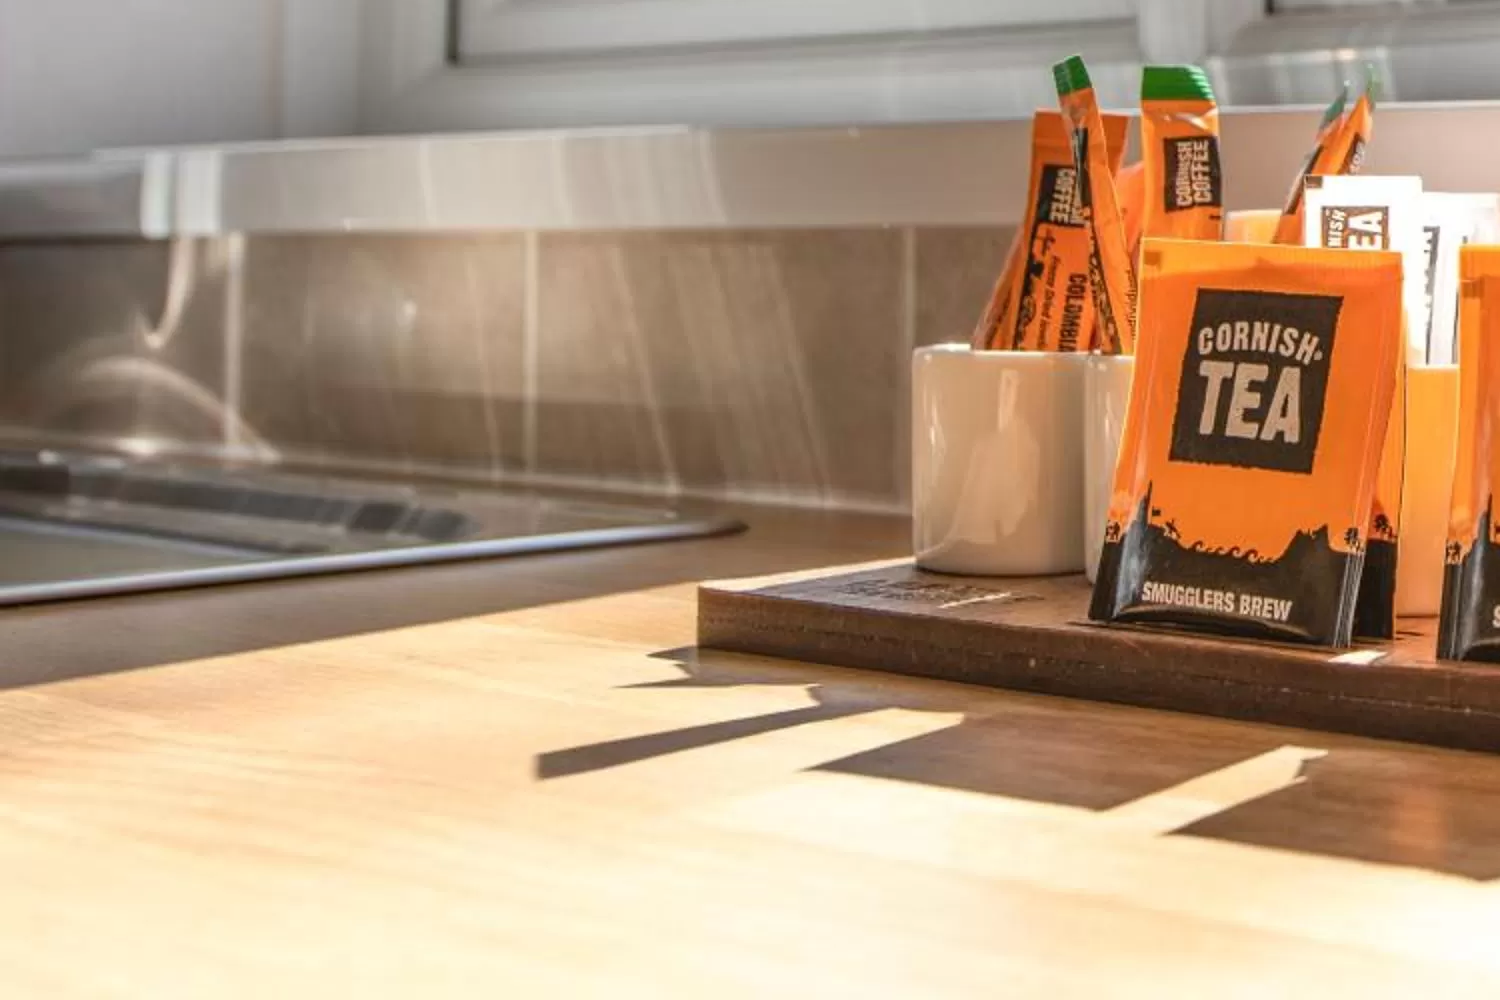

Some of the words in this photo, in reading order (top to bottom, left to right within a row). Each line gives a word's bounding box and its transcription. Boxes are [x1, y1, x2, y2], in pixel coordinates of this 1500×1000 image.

[1049, 167, 1077, 224] COFFEE
[1192, 139, 1213, 203] COFFEE
[1348, 211, 1384, 249] EA
[1198, 320, 1319, 365] CORNISH
[1198, 361, 1301, 443] TEA
[1142, 581, 1235, 614] SMUGGLERS
[1240, 594, 1294, 622] BREW
